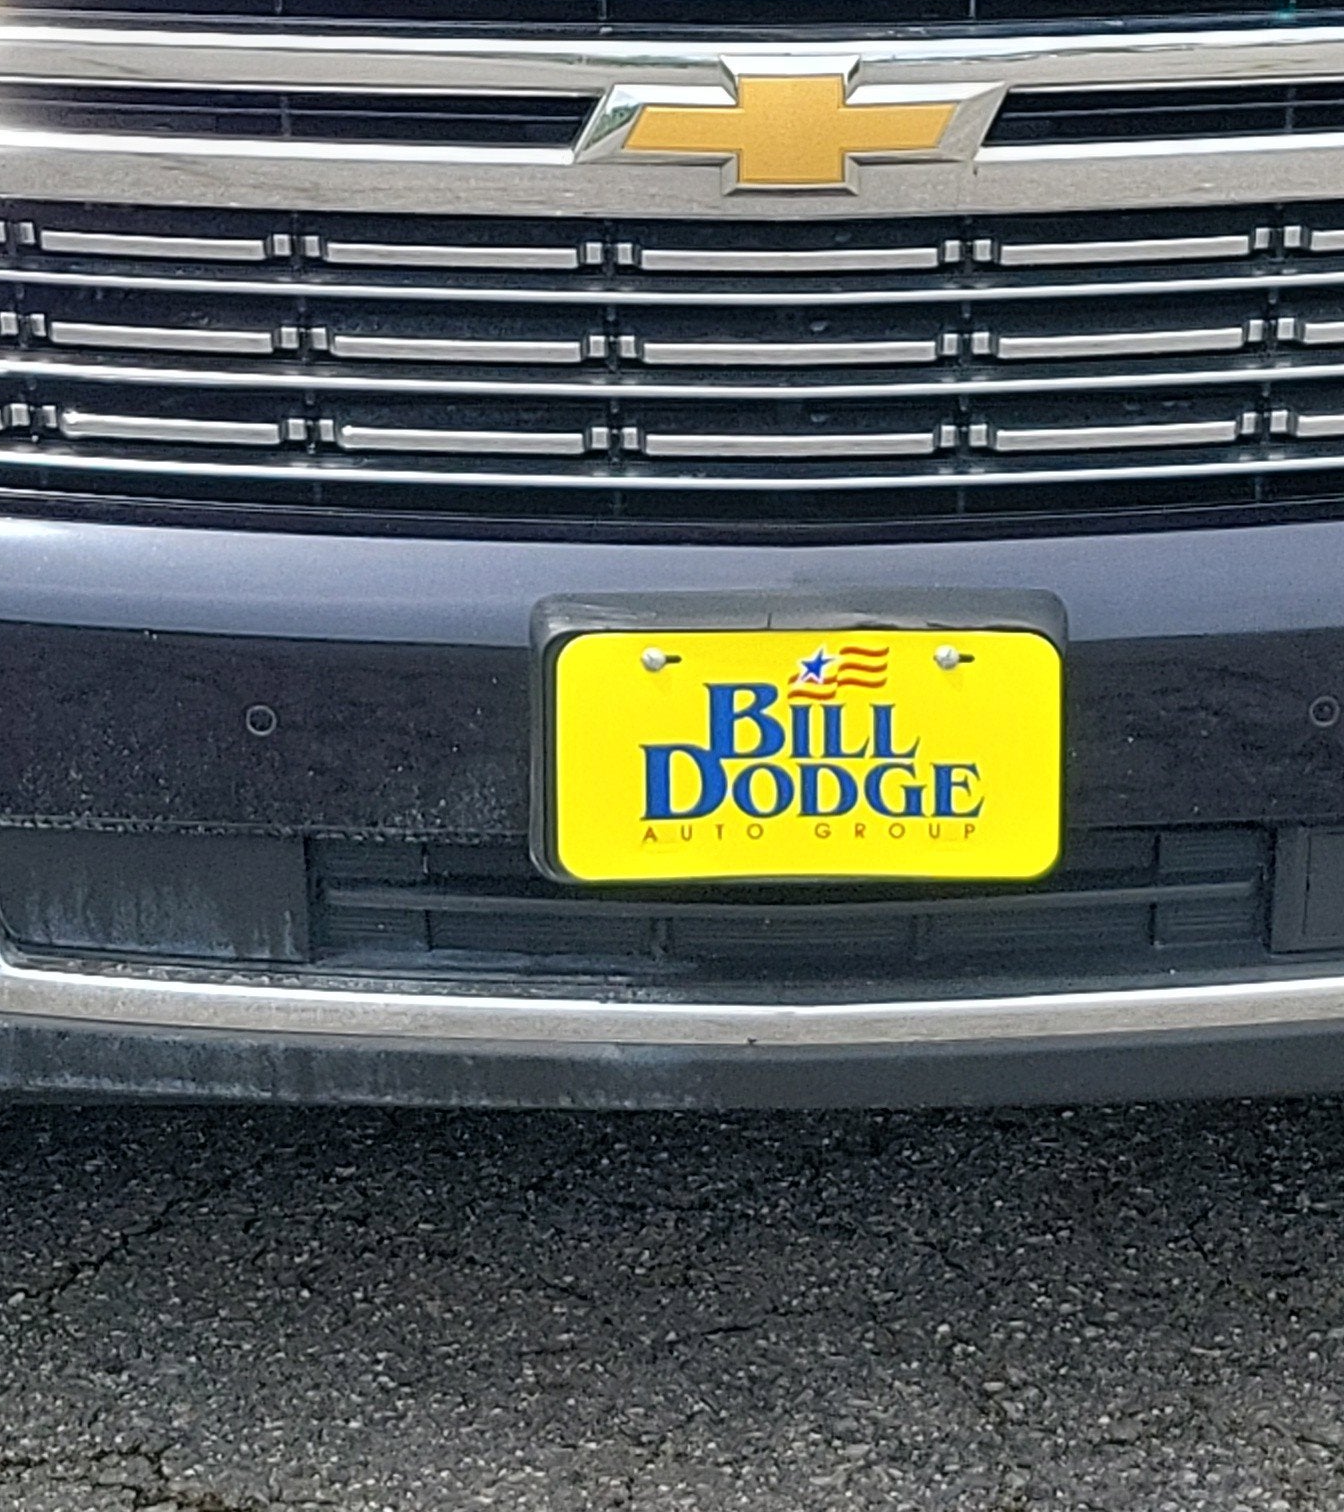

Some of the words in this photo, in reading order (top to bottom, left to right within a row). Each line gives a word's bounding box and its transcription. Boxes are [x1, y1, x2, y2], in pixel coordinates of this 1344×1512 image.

[703, 682, 921, 759] BILL
[638, 743, 985, 821] DODGE
[642, 823, 765, 843] AUTO
[814, 822, 976, 840] GROUP
